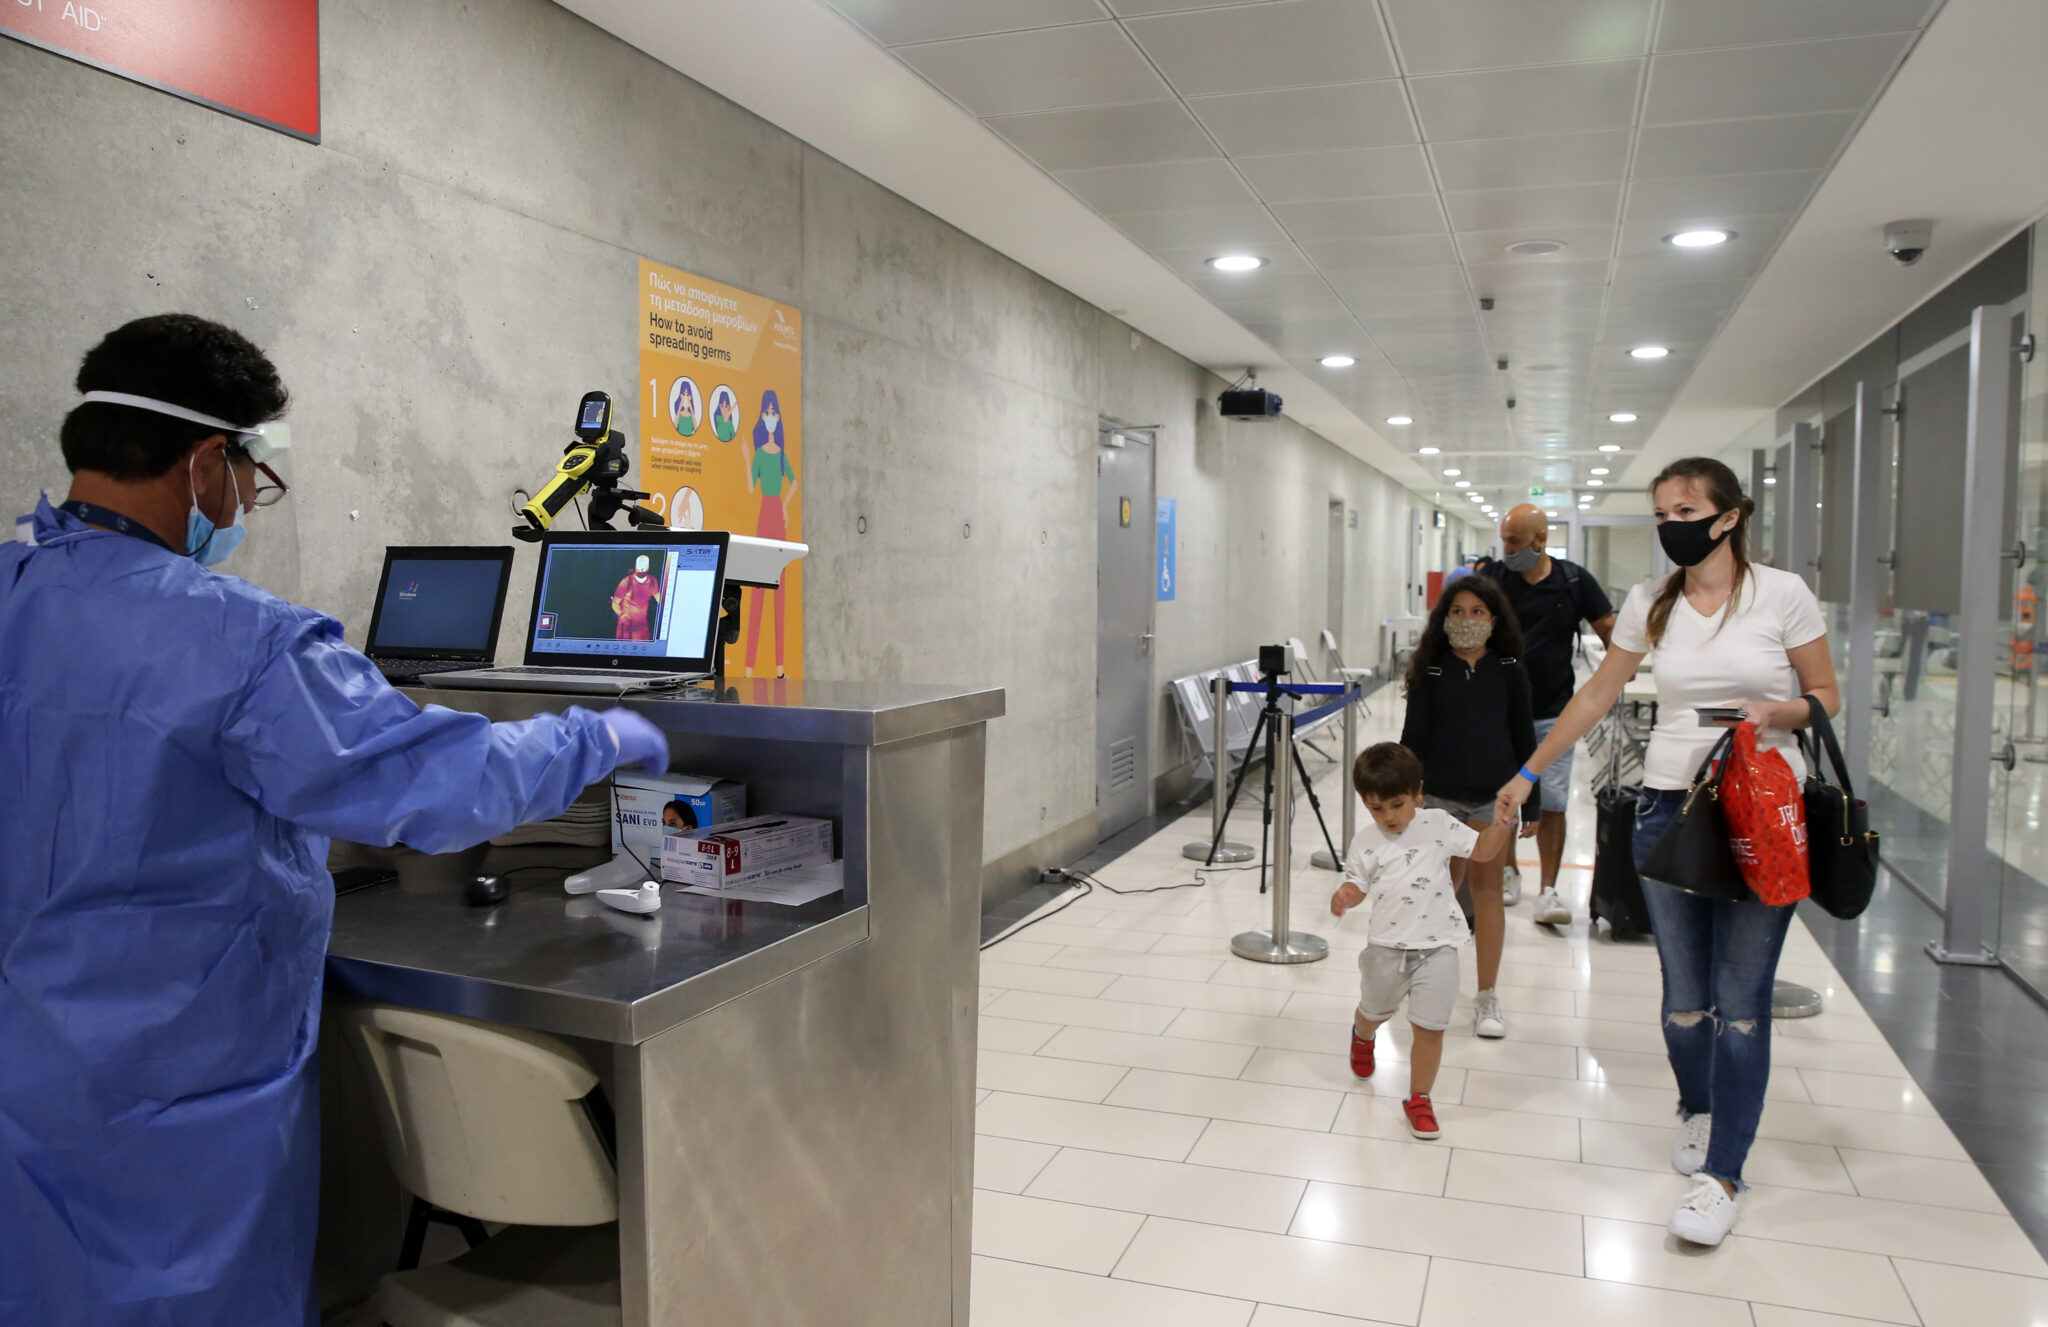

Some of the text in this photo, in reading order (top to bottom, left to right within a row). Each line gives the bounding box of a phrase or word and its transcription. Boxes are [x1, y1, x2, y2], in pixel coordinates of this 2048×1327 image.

[649, 272, 738, 312] Πώς να αποφύγετε
[649, 294, 662, 311] τη
[664, 298, 711, 325] μετάδοση
[649, 312, 713, 341] How to avoid
[649, 332, 731, 362] spreading germs
[650, 378, 658, 418] 1
[616, 813, 657, 827] SANI EVO
[726, 846, 739, 858] 8-9
